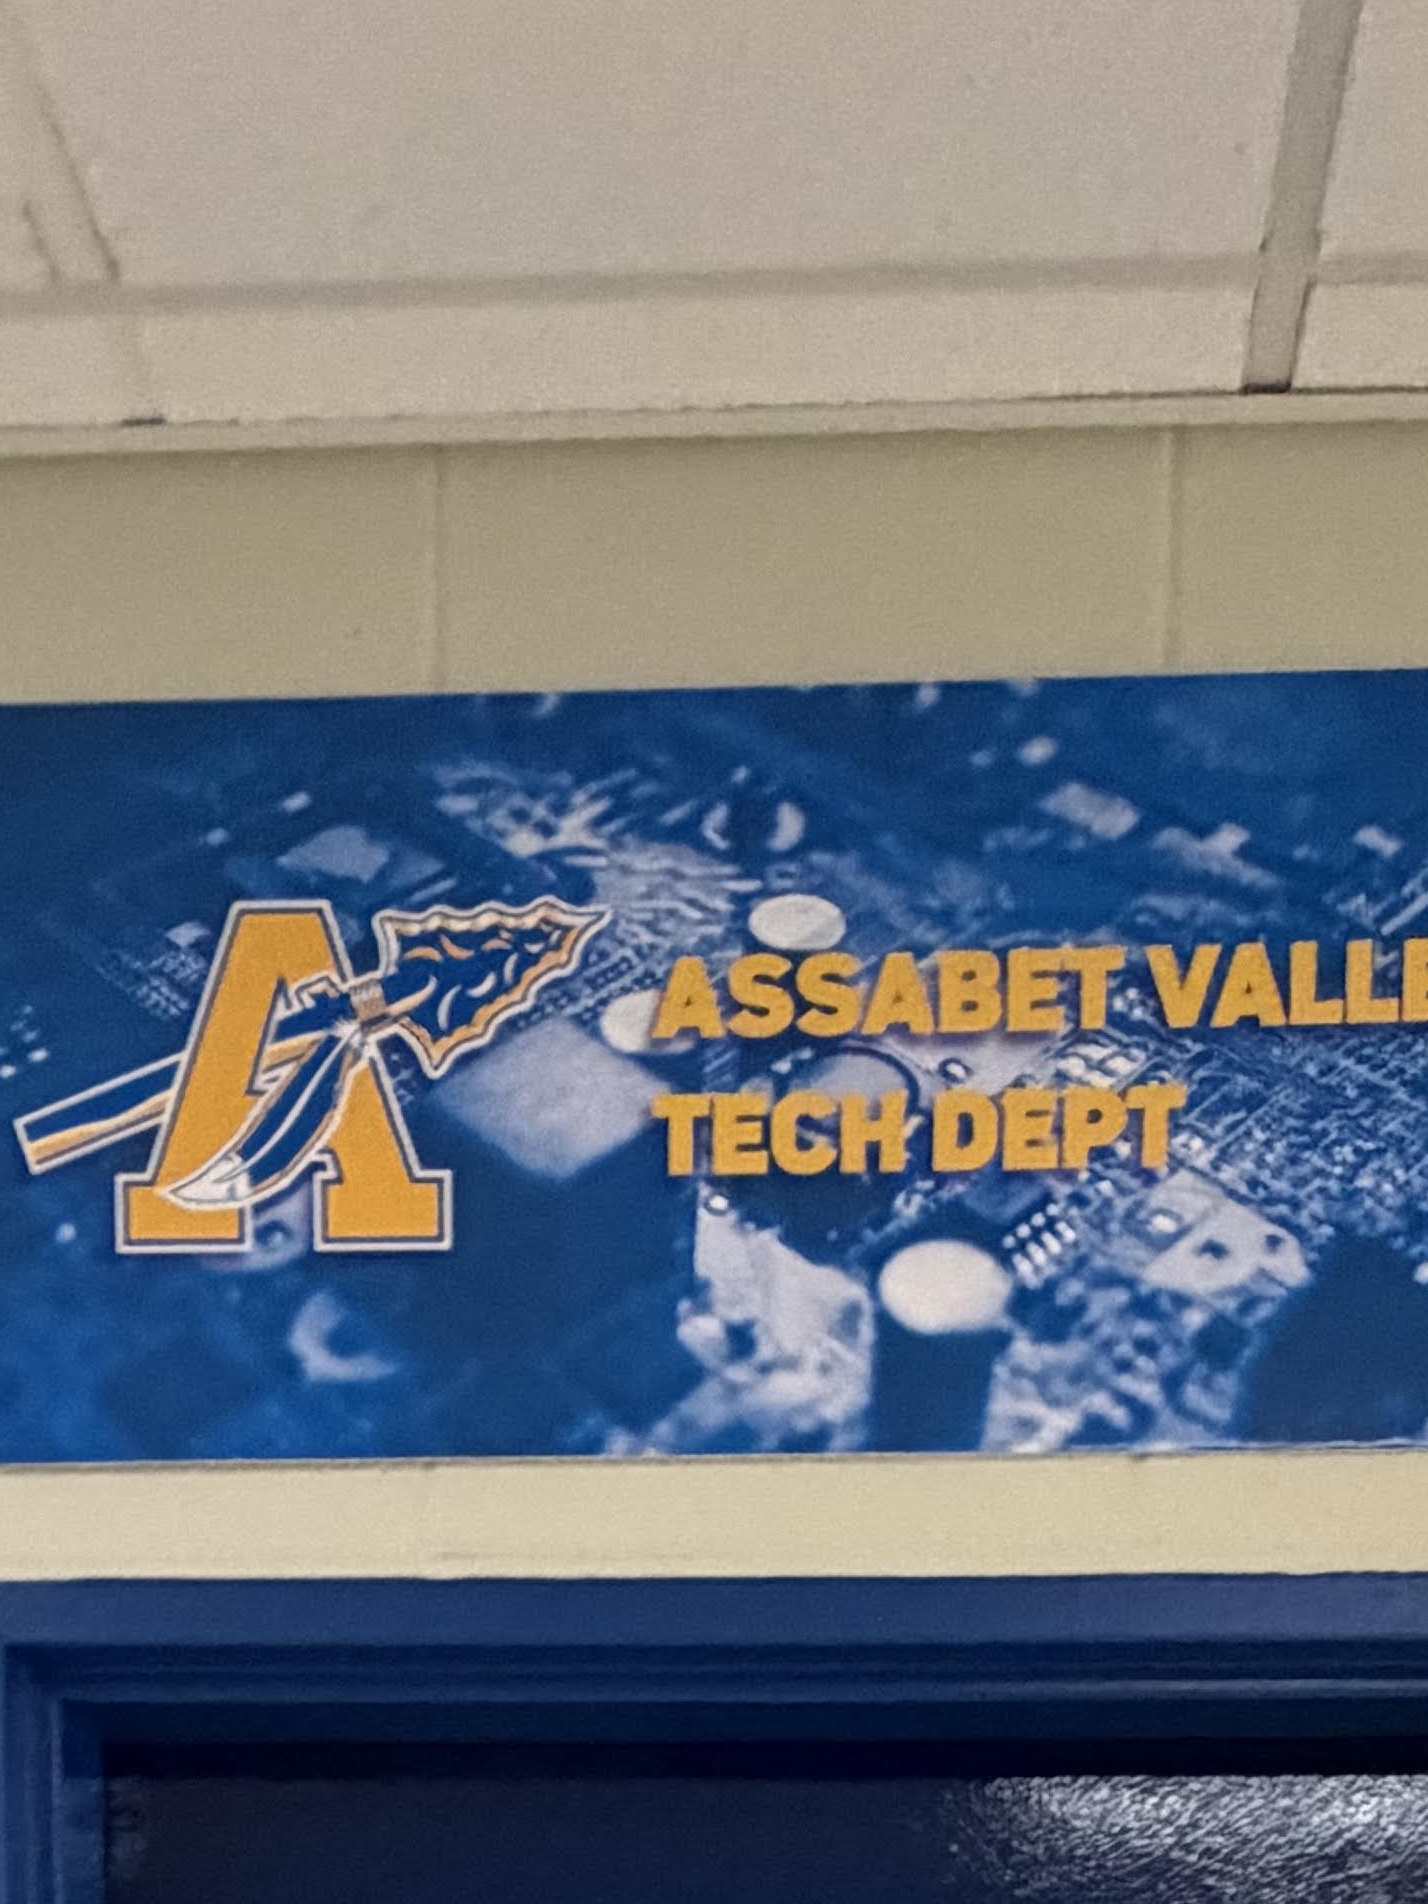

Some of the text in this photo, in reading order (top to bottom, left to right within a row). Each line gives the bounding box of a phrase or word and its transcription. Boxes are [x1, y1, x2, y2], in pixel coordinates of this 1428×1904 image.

[651, 946, 1124, 1038] ASSABET
[651, 1083, 1186, 1176] TECH DEPT
